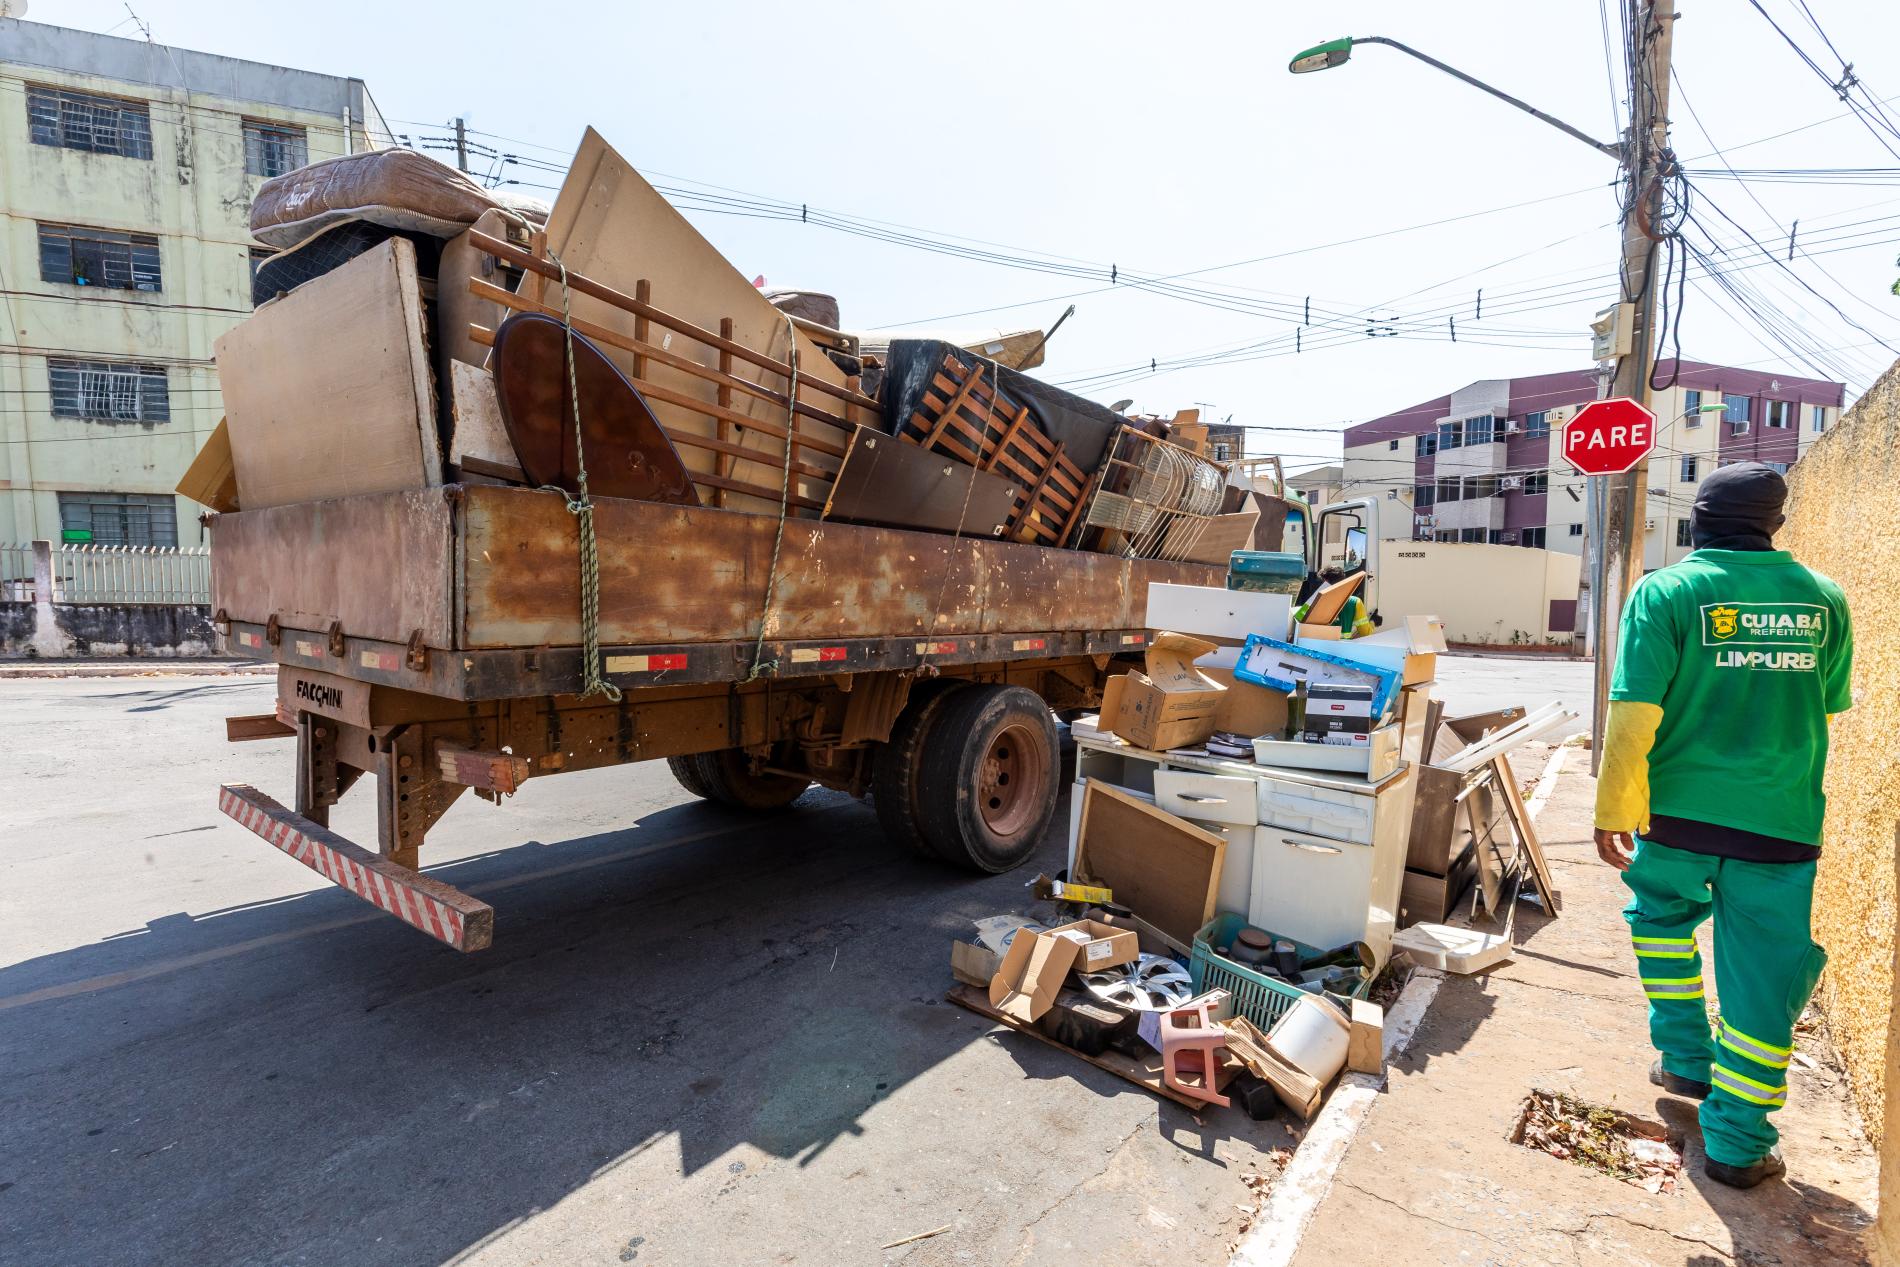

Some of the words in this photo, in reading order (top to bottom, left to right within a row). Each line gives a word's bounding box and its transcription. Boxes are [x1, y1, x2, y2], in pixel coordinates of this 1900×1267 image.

[1569, 423, 1647, 452] PARE
[1741, 612, 1823, 631] CUIABÁ
[1750, 628, 1816, 637] PREFEITURA
[1715, 650, 1816, 670] LIMPURB
